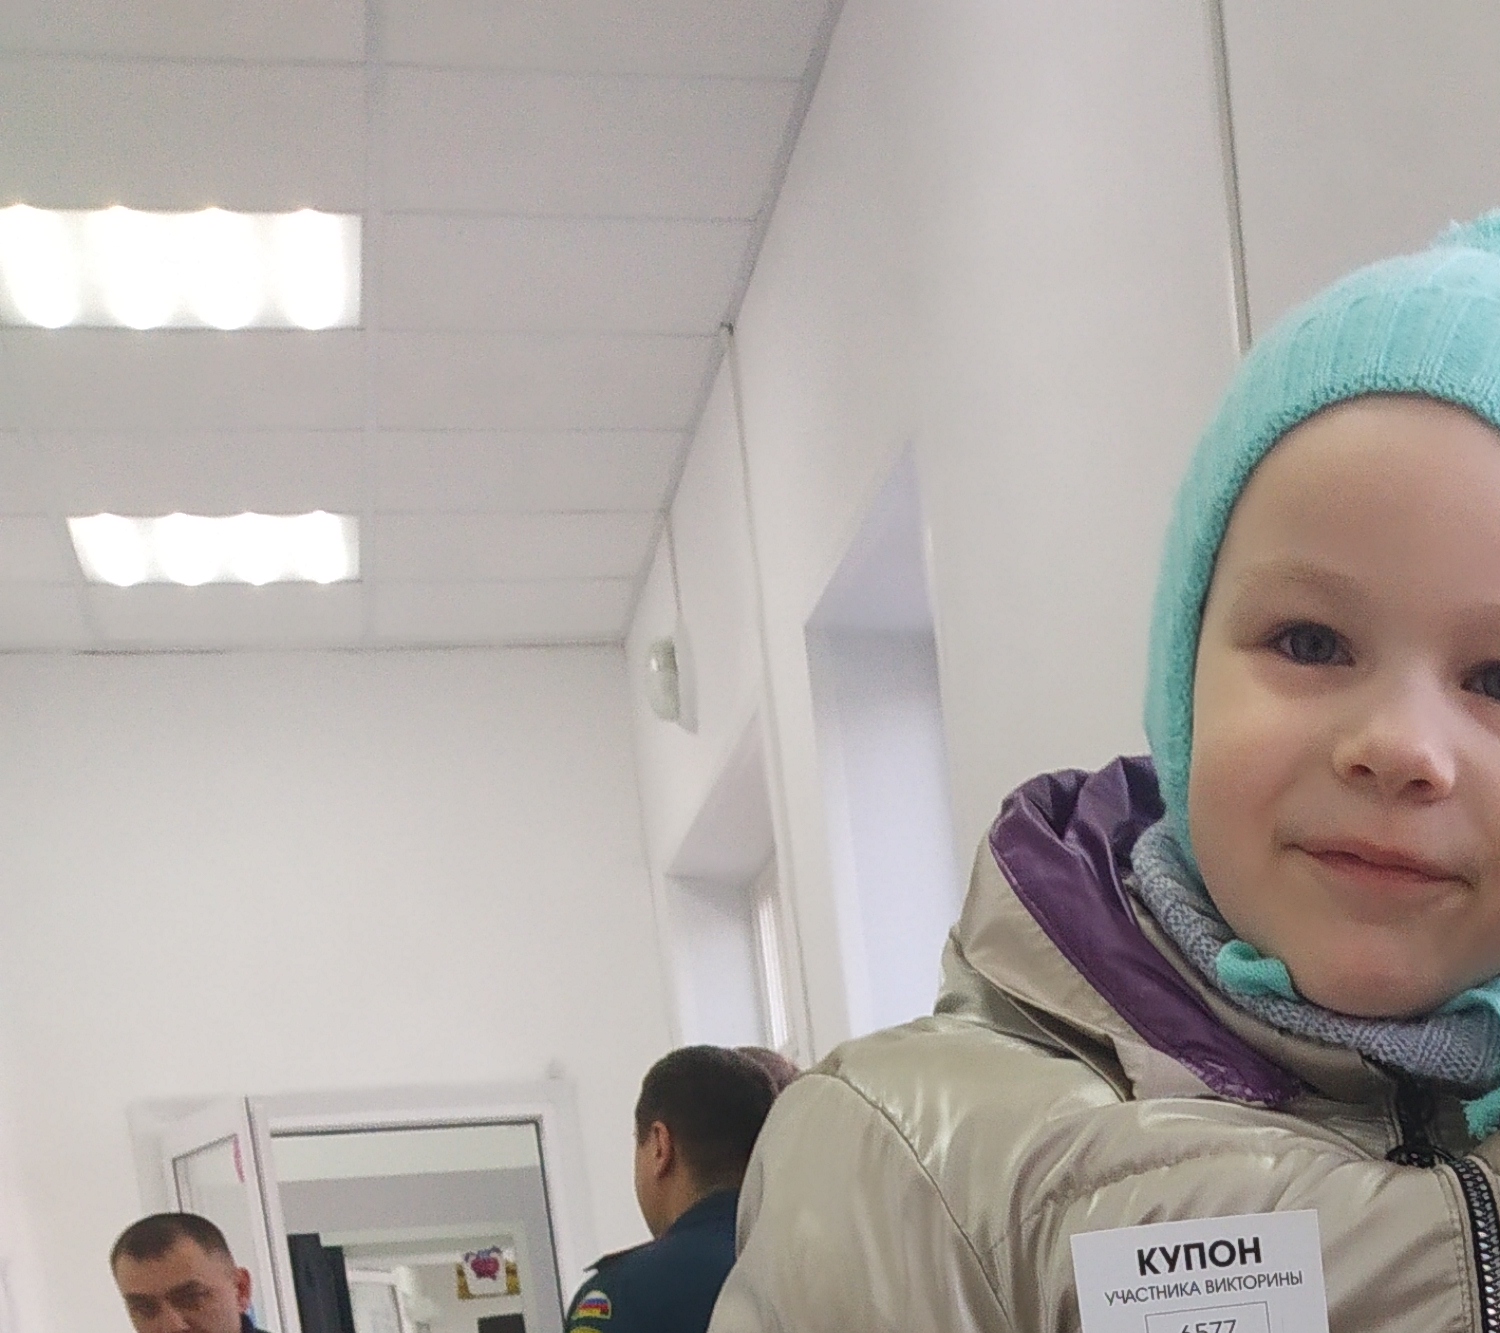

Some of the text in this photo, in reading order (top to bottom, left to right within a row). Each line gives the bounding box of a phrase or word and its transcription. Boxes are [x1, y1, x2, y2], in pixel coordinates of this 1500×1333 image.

[1136, 1236, 1263, 1277] КУПОН
[1104, 1269, 1303, 1307] УЧАСТНИКА ВИКТОРИНЫ
